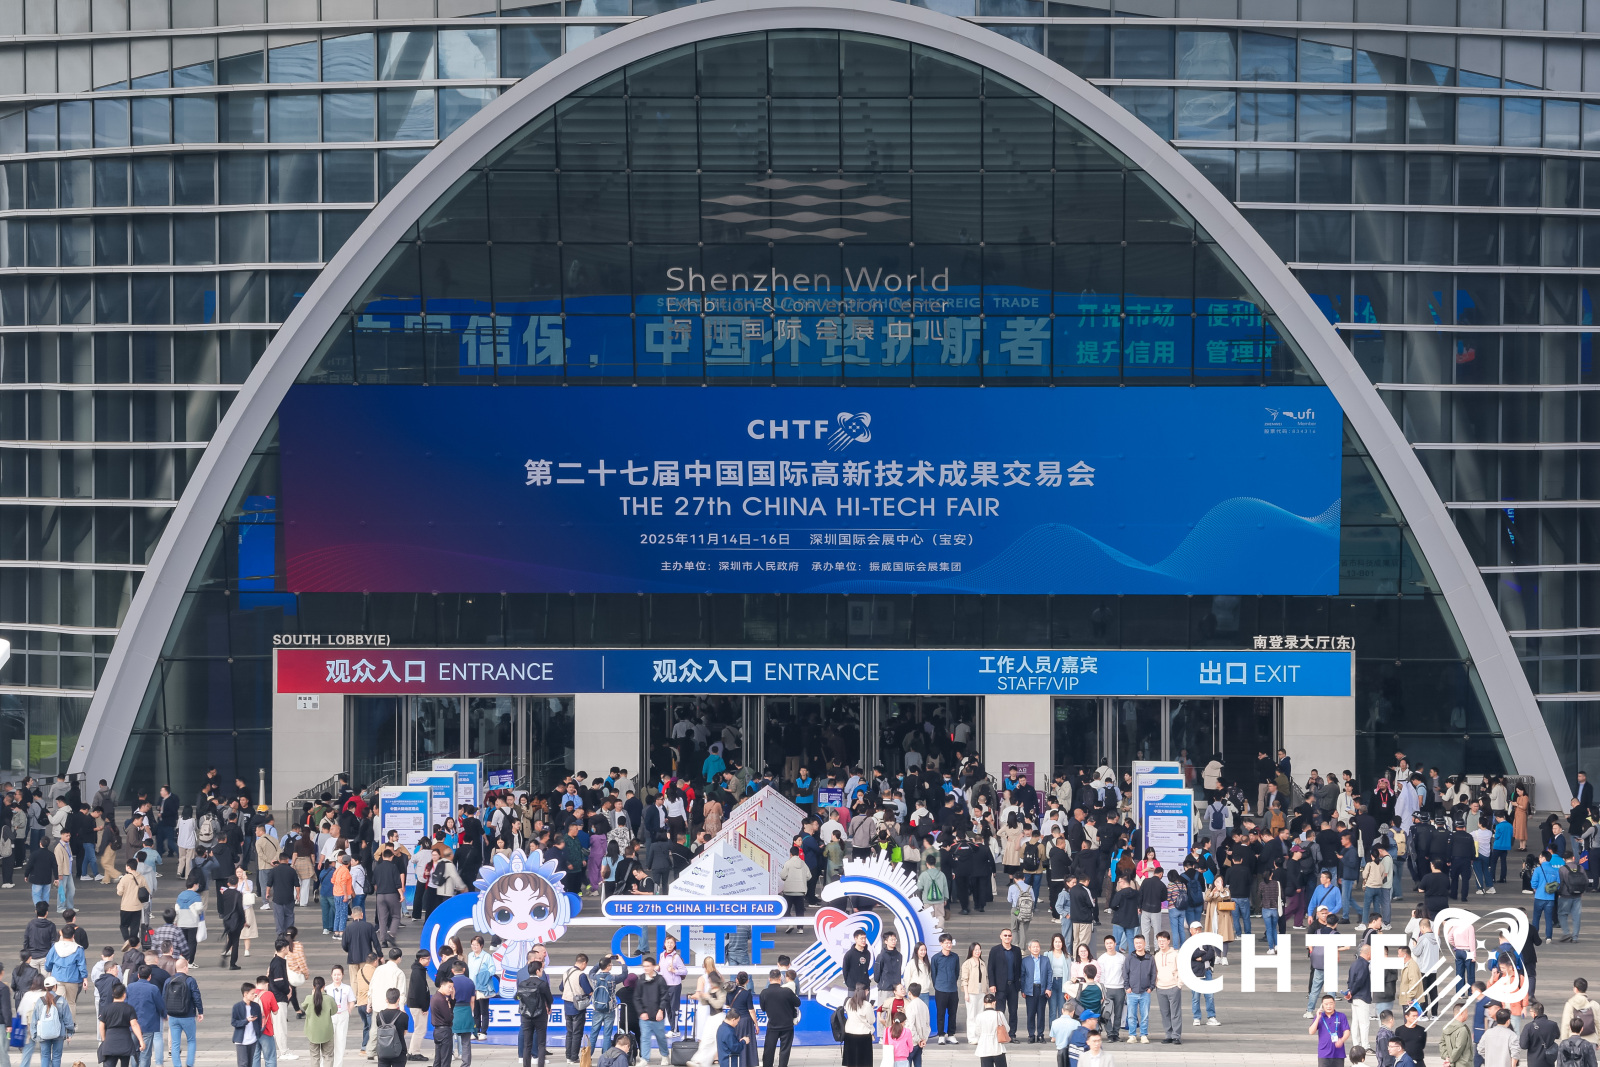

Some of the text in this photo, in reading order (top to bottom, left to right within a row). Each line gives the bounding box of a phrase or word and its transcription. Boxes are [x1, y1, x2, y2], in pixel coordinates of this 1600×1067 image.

[666, 267, 949, 292] Shenzhen World
[666, 297, 949, 313] Exhibition & Convention Center
[994, 298, 1039, 308] TRADE
[1077, 303, 1176, 328] 开拓市场
[667, 319, 949, 341] 深圳国际会展中心
[747, 419, 830, 440] CHTF
[524, 458, 1096, 487] 第二十七届中国国际高新技术成果交易会
[619, 496, 1001, 517] THE 27th CHINA HI-TECH FAIR
[640, 533, 791, 546] 2025年11月14日-16日
[272, 634, 391, 646] SOUTH LOBBY(E)
[325, 658, 554, 683] 观众入口 ENTRANCE
[652, 658, 880, 683] 观众入口 ENTRANCE
[978, 655, 1099, 675] 工作人员/嘉宾
[1199, 661, 1301, 685] 出口 EXIT
[997, 676, 1079, 692] STAFF/VIP
[614, 903, 775, 914] THE 27th CHINA HI-TECH FAIR
